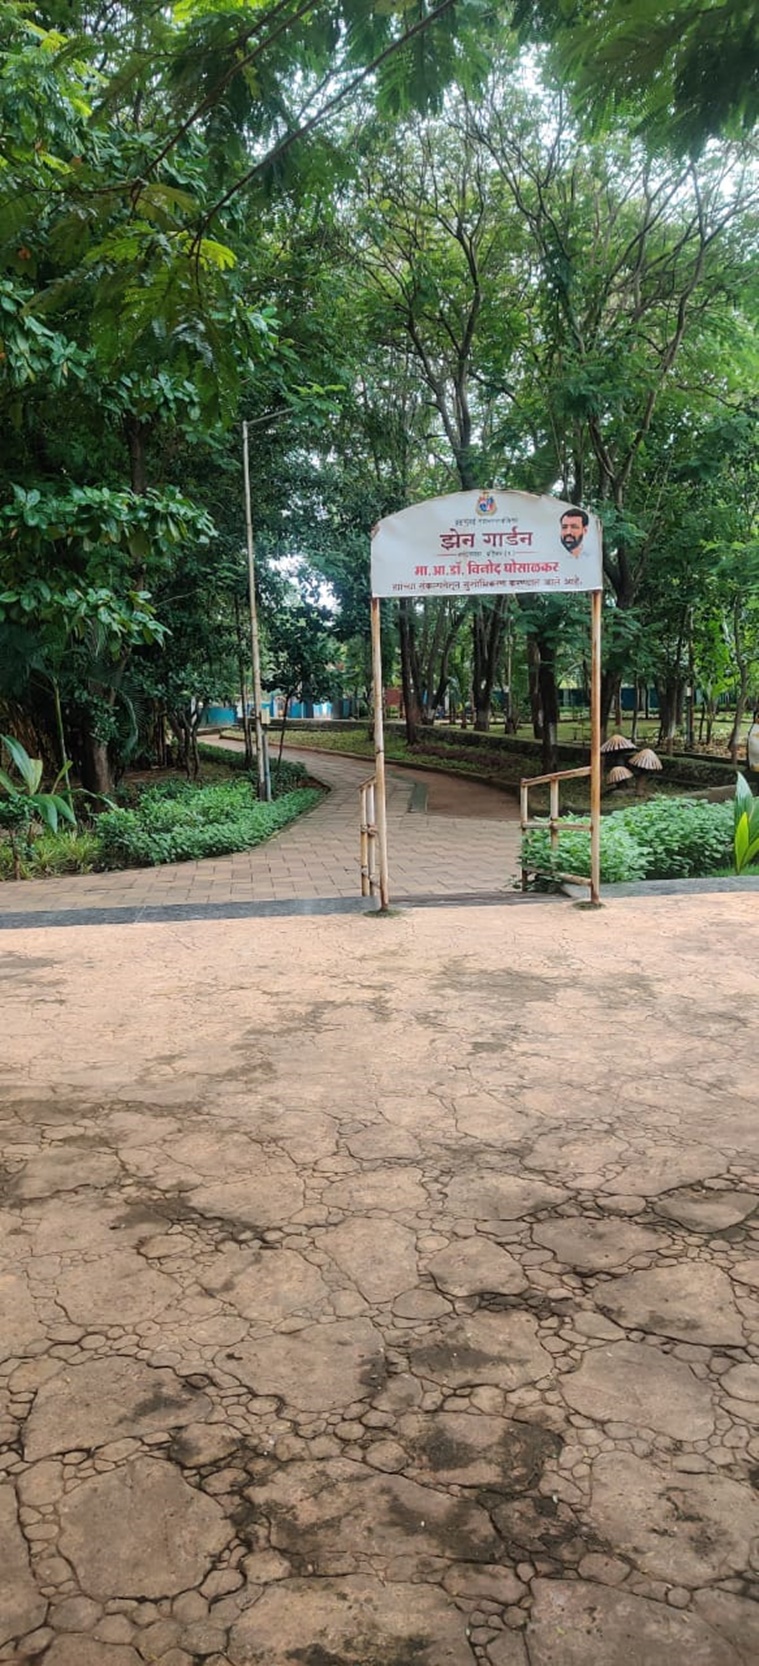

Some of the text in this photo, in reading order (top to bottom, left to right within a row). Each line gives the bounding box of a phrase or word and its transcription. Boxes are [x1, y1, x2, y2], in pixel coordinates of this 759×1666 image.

[439, 526, 533, 550] झेन गार्डन
[467, 559, 501, 575] विनोद
[504, 559, 559, 574] घोसाळकर
